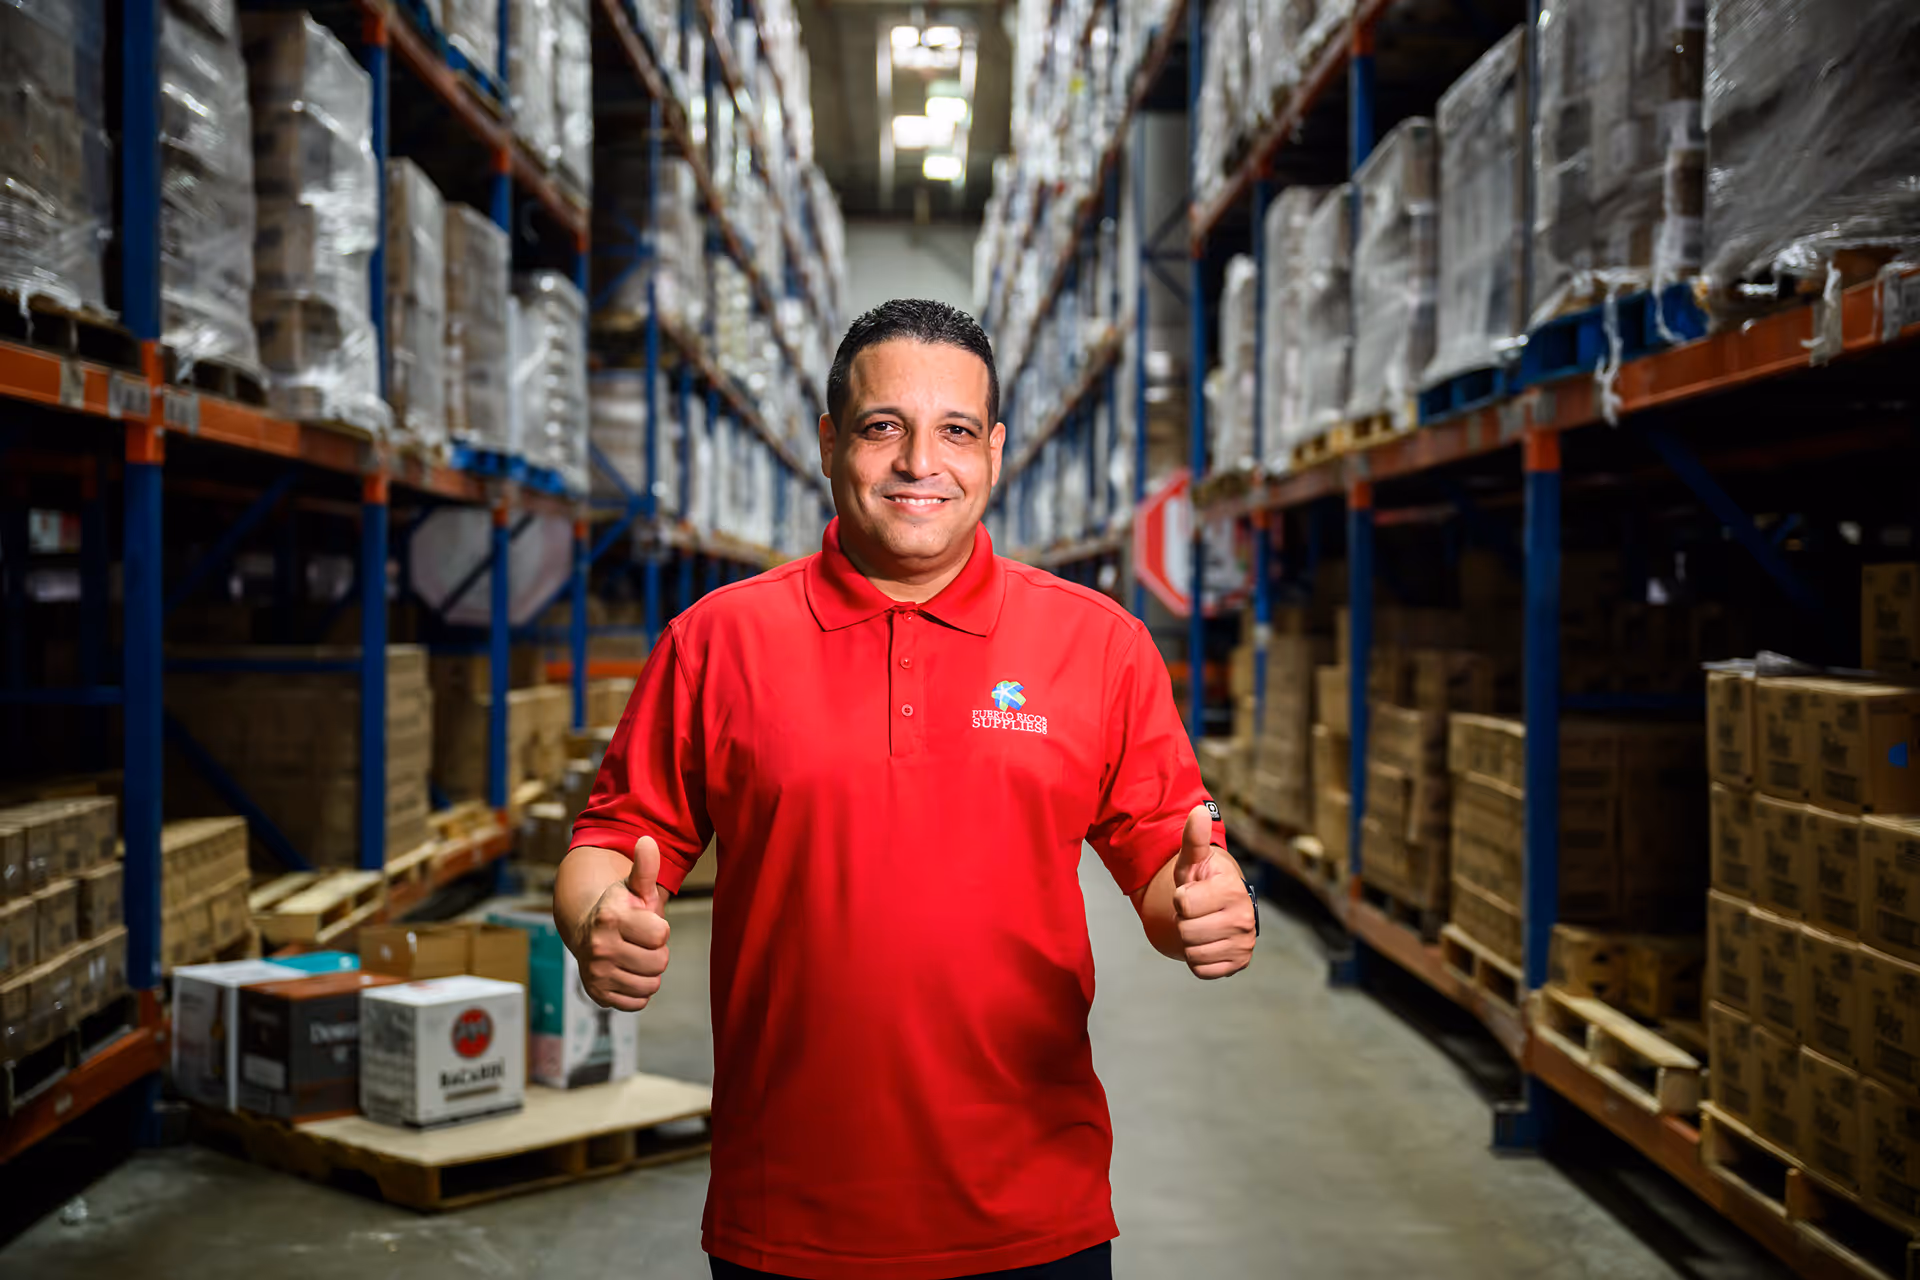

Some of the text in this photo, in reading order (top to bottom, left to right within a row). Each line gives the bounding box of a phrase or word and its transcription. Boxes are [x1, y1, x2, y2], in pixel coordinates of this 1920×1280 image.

[972, 710, 1042, 723] PUERTO RICO
[972, 717, 1042, 733] SUPPLIES
